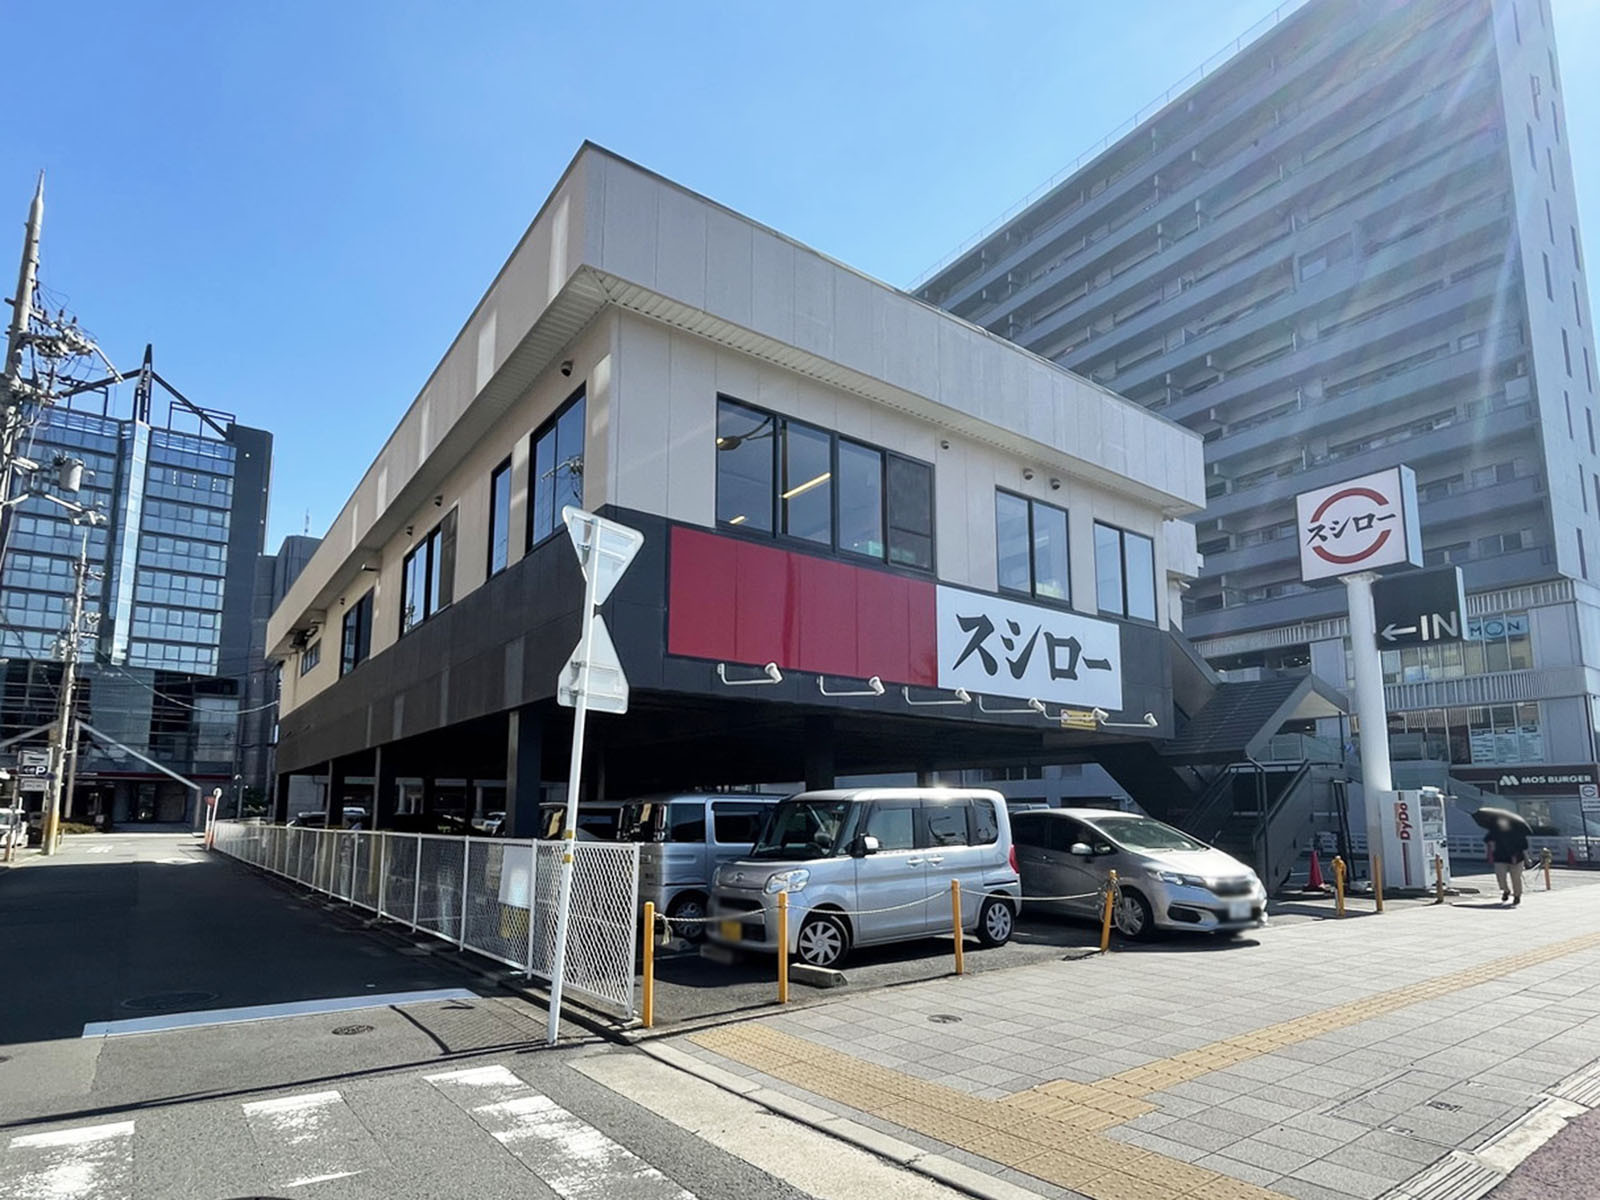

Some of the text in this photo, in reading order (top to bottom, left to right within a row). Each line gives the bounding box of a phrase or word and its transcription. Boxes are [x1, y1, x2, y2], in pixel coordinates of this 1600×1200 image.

[1305, 512, 1397, 545] スシロー
[1420, 610, 1459, 641] IN
[952, 613, 1112, 681] スシロー
[36, 766, 46, 775] P
[1521, 774, 1592, 784] MOS BURGER
[1398, 802, 1413, 841] DyDo
